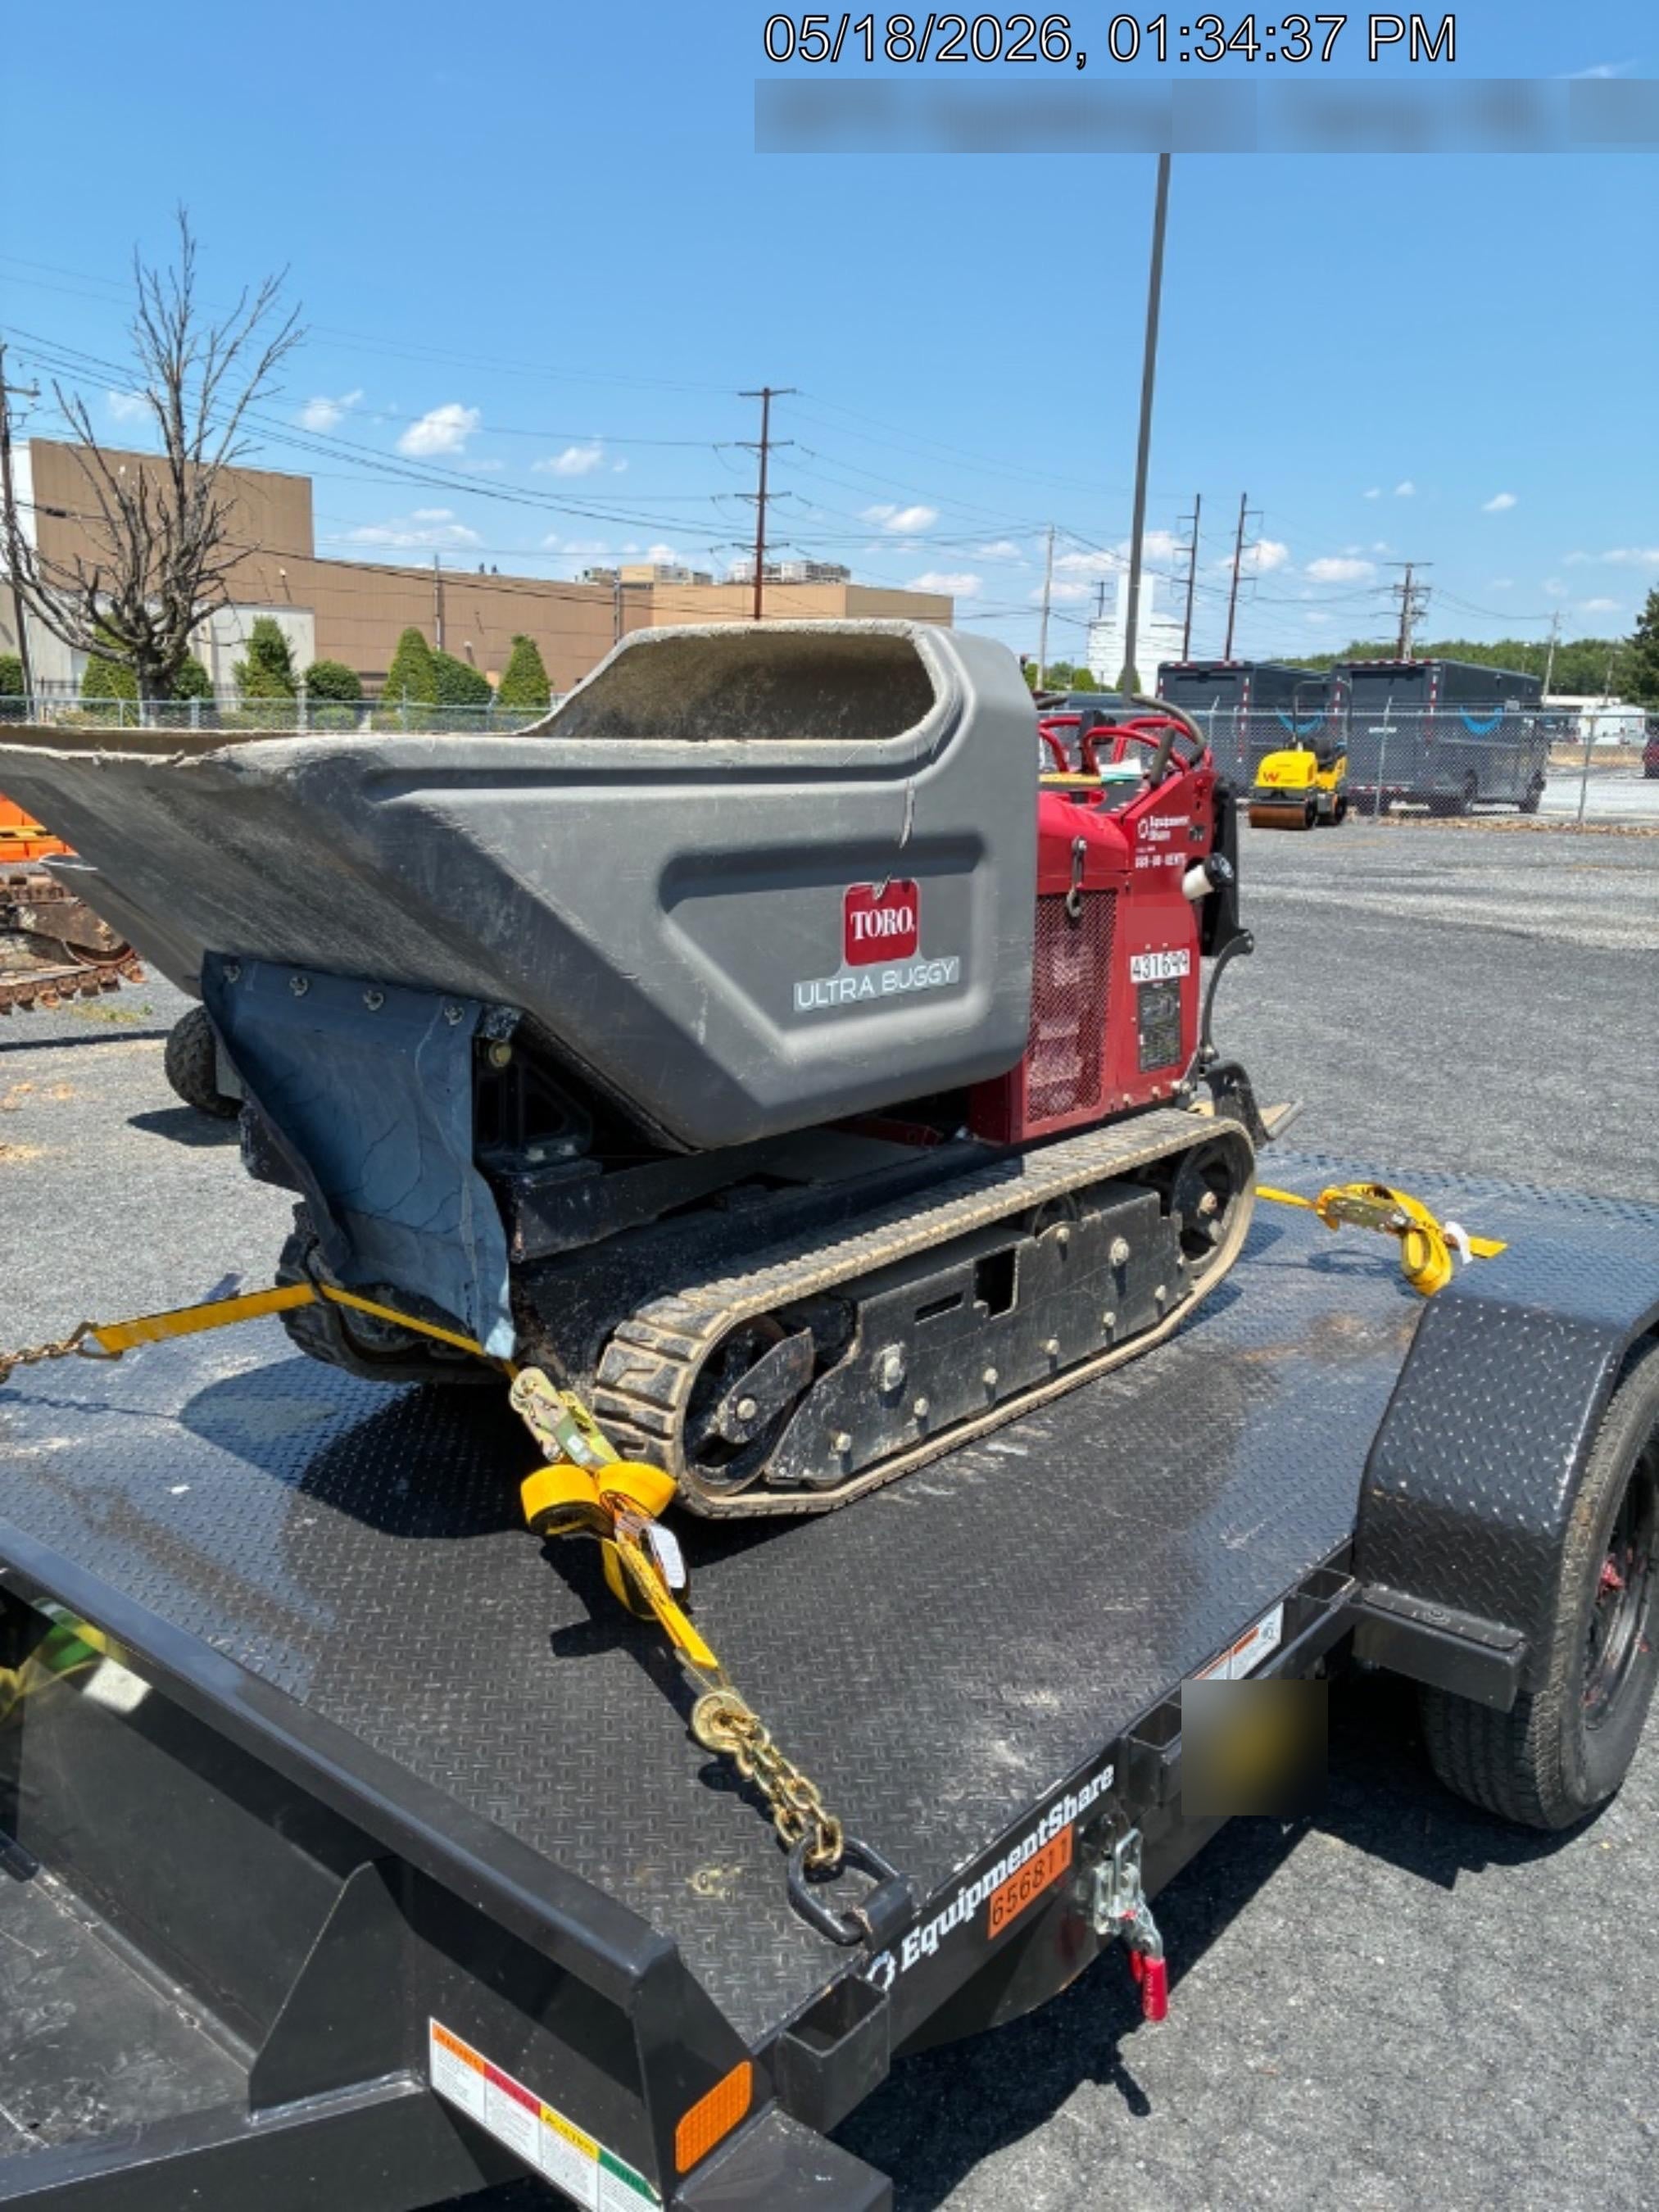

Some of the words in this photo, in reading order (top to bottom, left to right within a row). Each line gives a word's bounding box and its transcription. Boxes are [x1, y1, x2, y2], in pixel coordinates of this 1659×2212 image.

[850, 906, 913, 941] TORO
[797, 974, 875, 1008] ULTRA
[882, 960, 955, 992] BUGGY
[902, 1763, 1115, 1973] EquipmentShare
